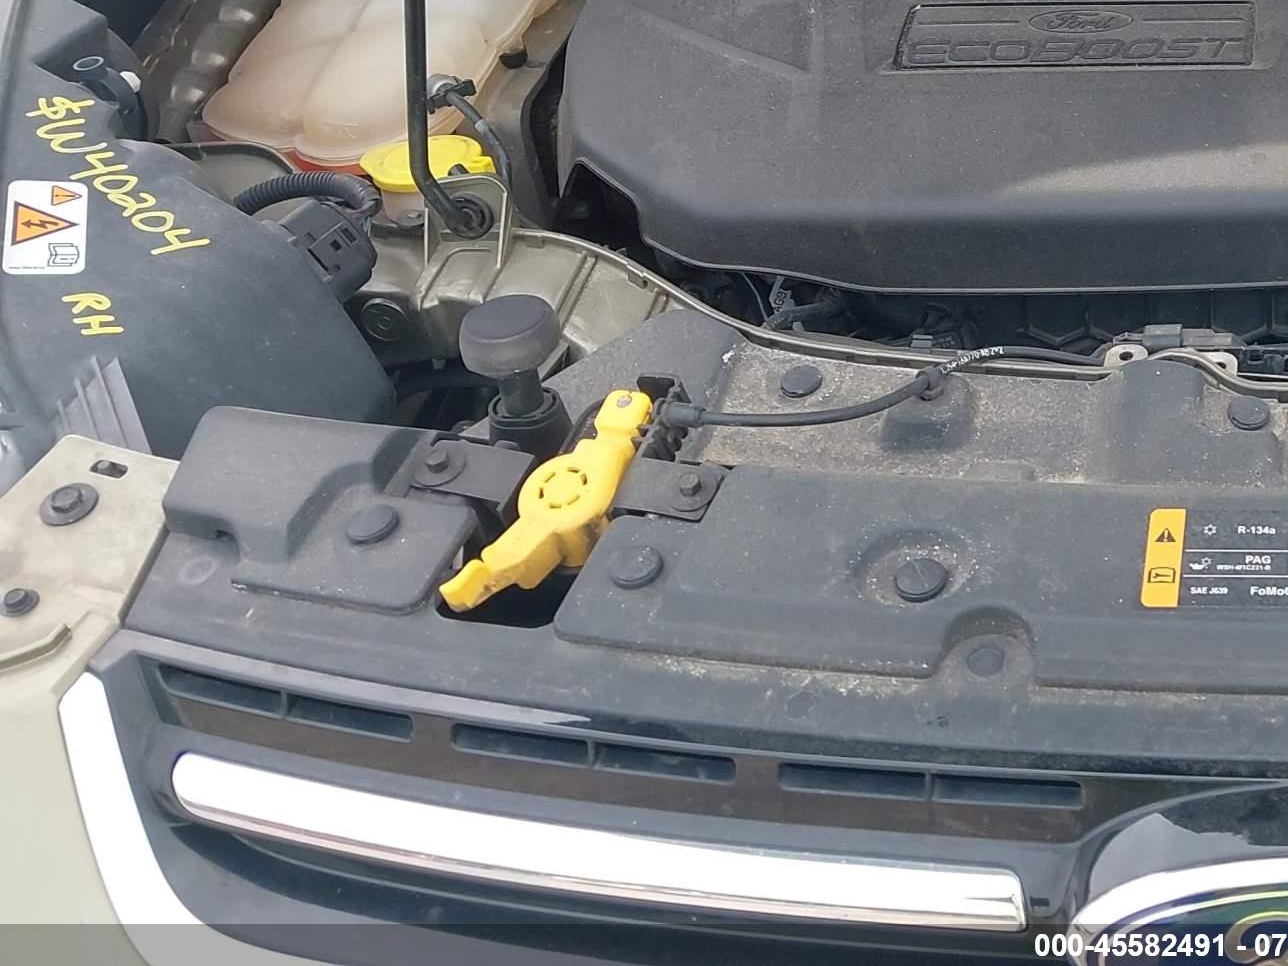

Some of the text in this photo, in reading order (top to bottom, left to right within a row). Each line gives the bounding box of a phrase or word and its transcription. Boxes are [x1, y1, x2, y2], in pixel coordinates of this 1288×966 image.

[1048, 11, 1115, 32] Ford
[907, 37, 1245, 63] ECOBOOST
[61, 292, 124, 335] RH
[1237, 525, 1277, 535] R-134a
[1245, 554, 1272, 564] PAG
[1190, 586, 1208, 595] SAE
